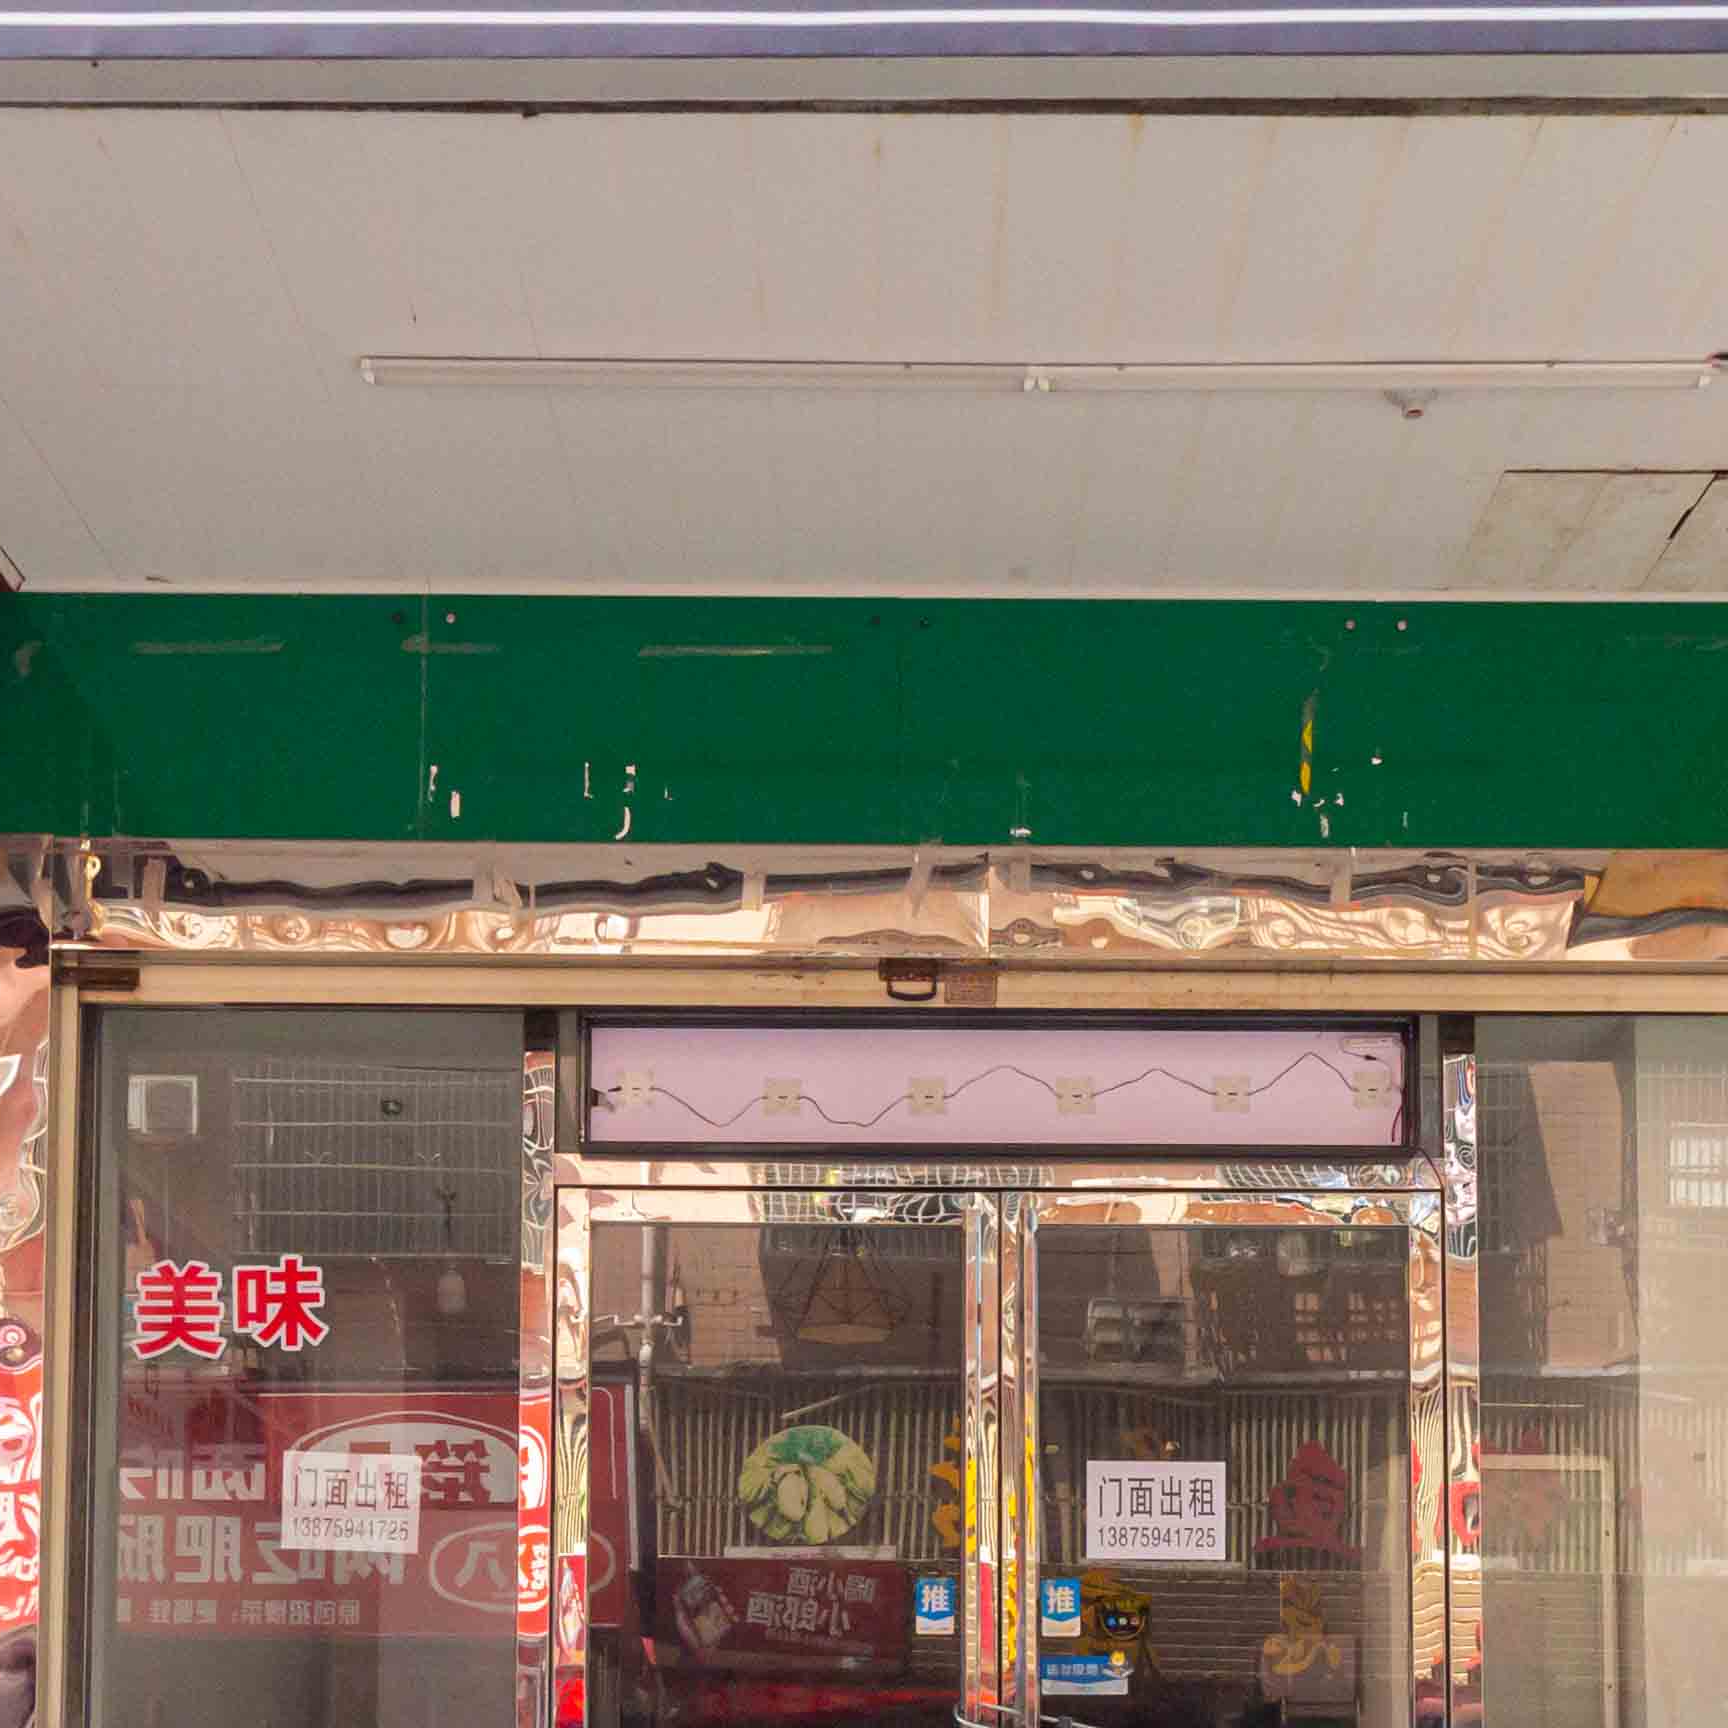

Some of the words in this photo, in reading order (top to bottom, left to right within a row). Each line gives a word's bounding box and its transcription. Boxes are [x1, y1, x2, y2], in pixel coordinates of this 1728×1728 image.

[131, 1254, 330, 1360] 美味
[292, 1466, 410, 1513] 门面出租
[1098, 1476, 1217, 1519] 门面出租
[1098, 1527, 1217, 1550] 13875941725
[921, 1584, 950, 1614] 推
[1046, 1585, 1076, 1615] 推
